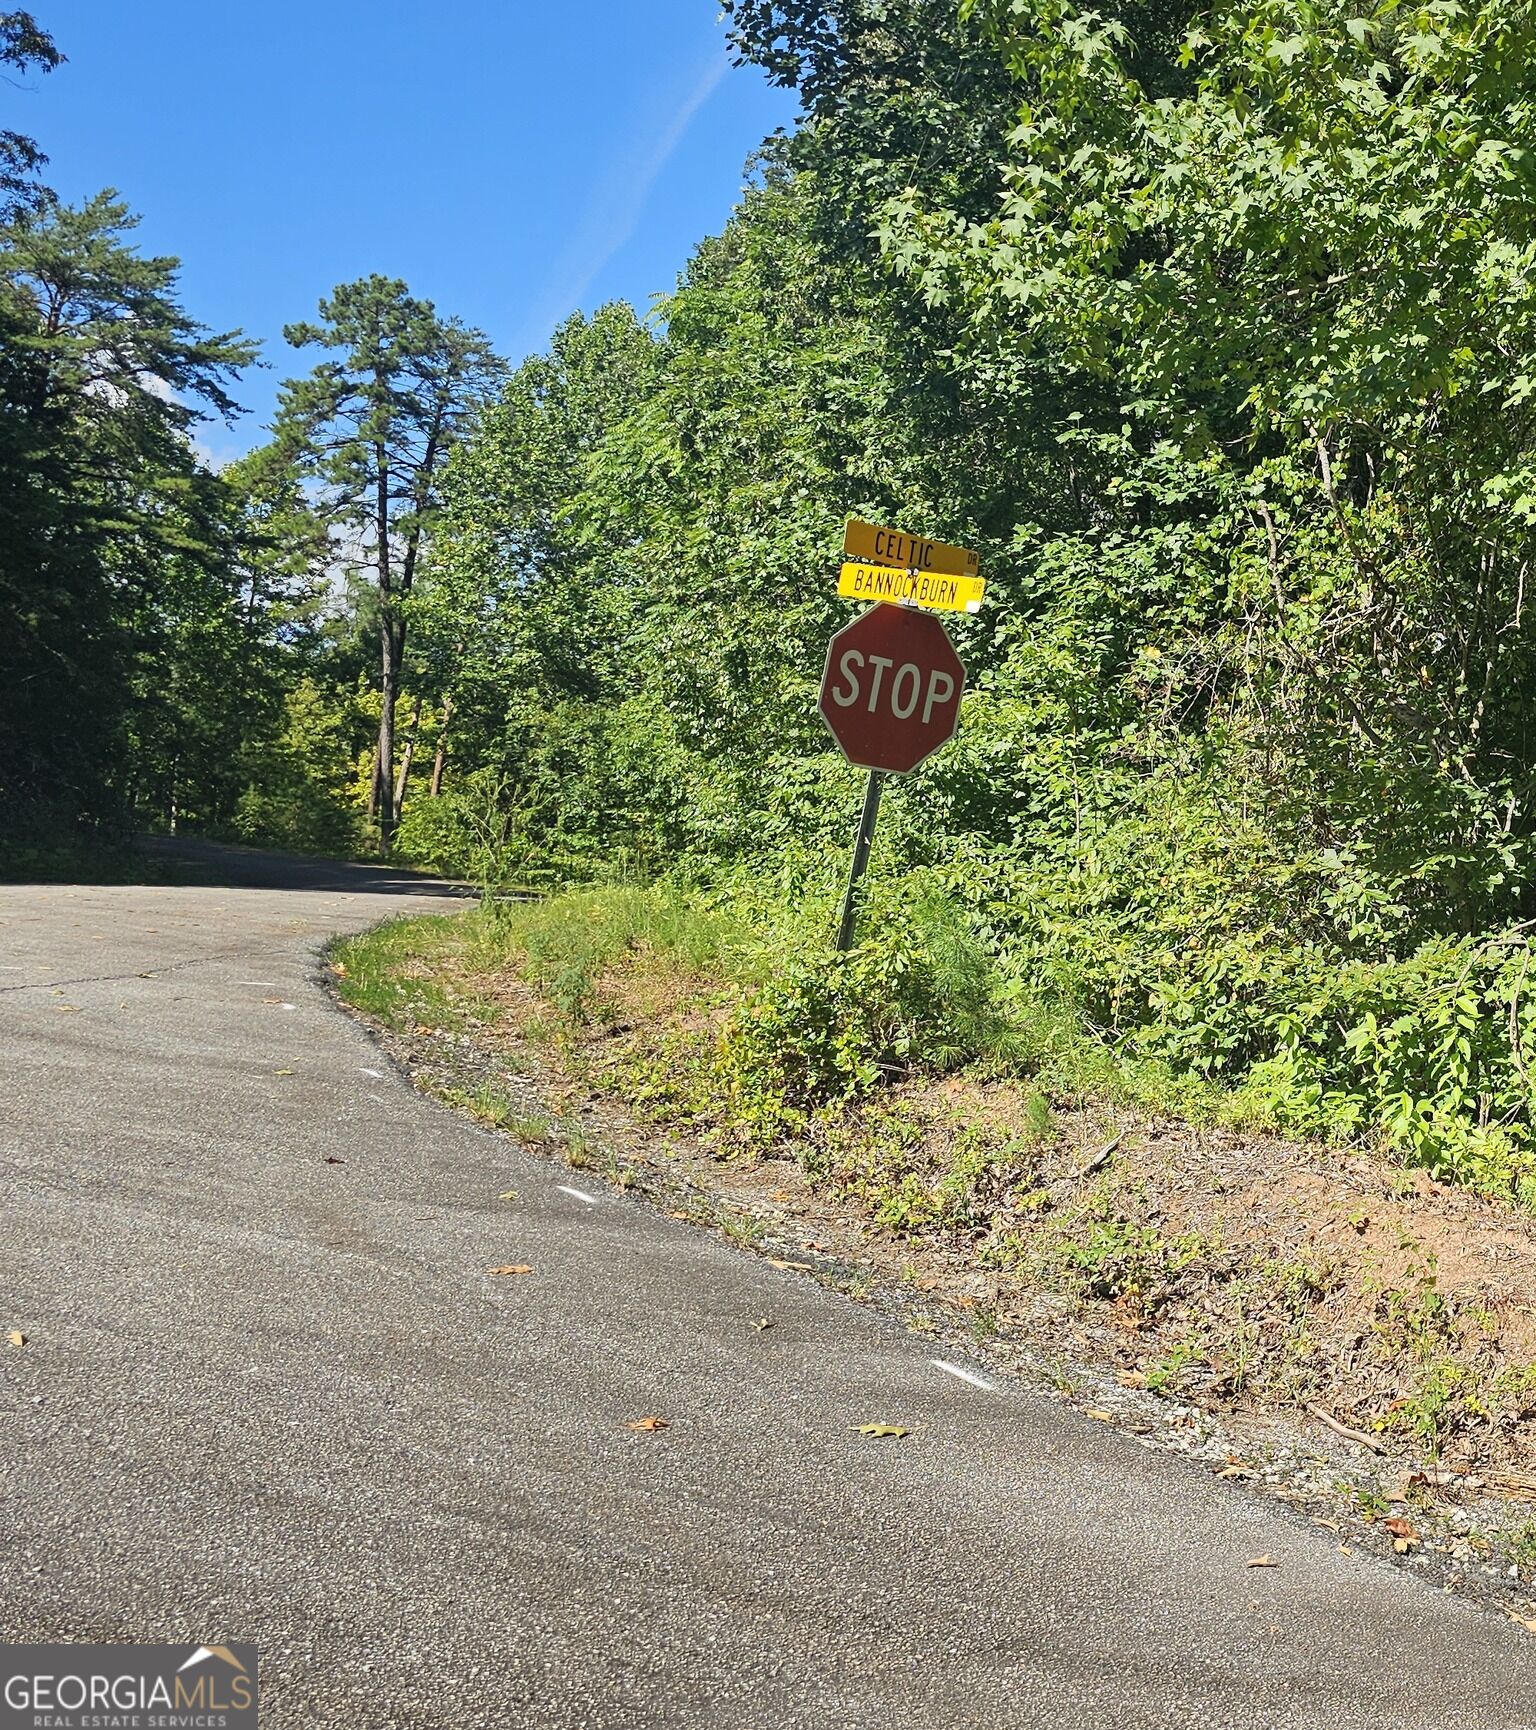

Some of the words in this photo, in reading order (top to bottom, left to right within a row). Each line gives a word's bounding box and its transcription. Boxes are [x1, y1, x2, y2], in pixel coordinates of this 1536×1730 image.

[875, 531, 934, 567] CELTIC
[967, 552, 978, 566] DR
[854, 569, 958, 604] BANNOCKBURN
[972, 581, 983, 593] DR
[832, 649, 955, 724] STOP
